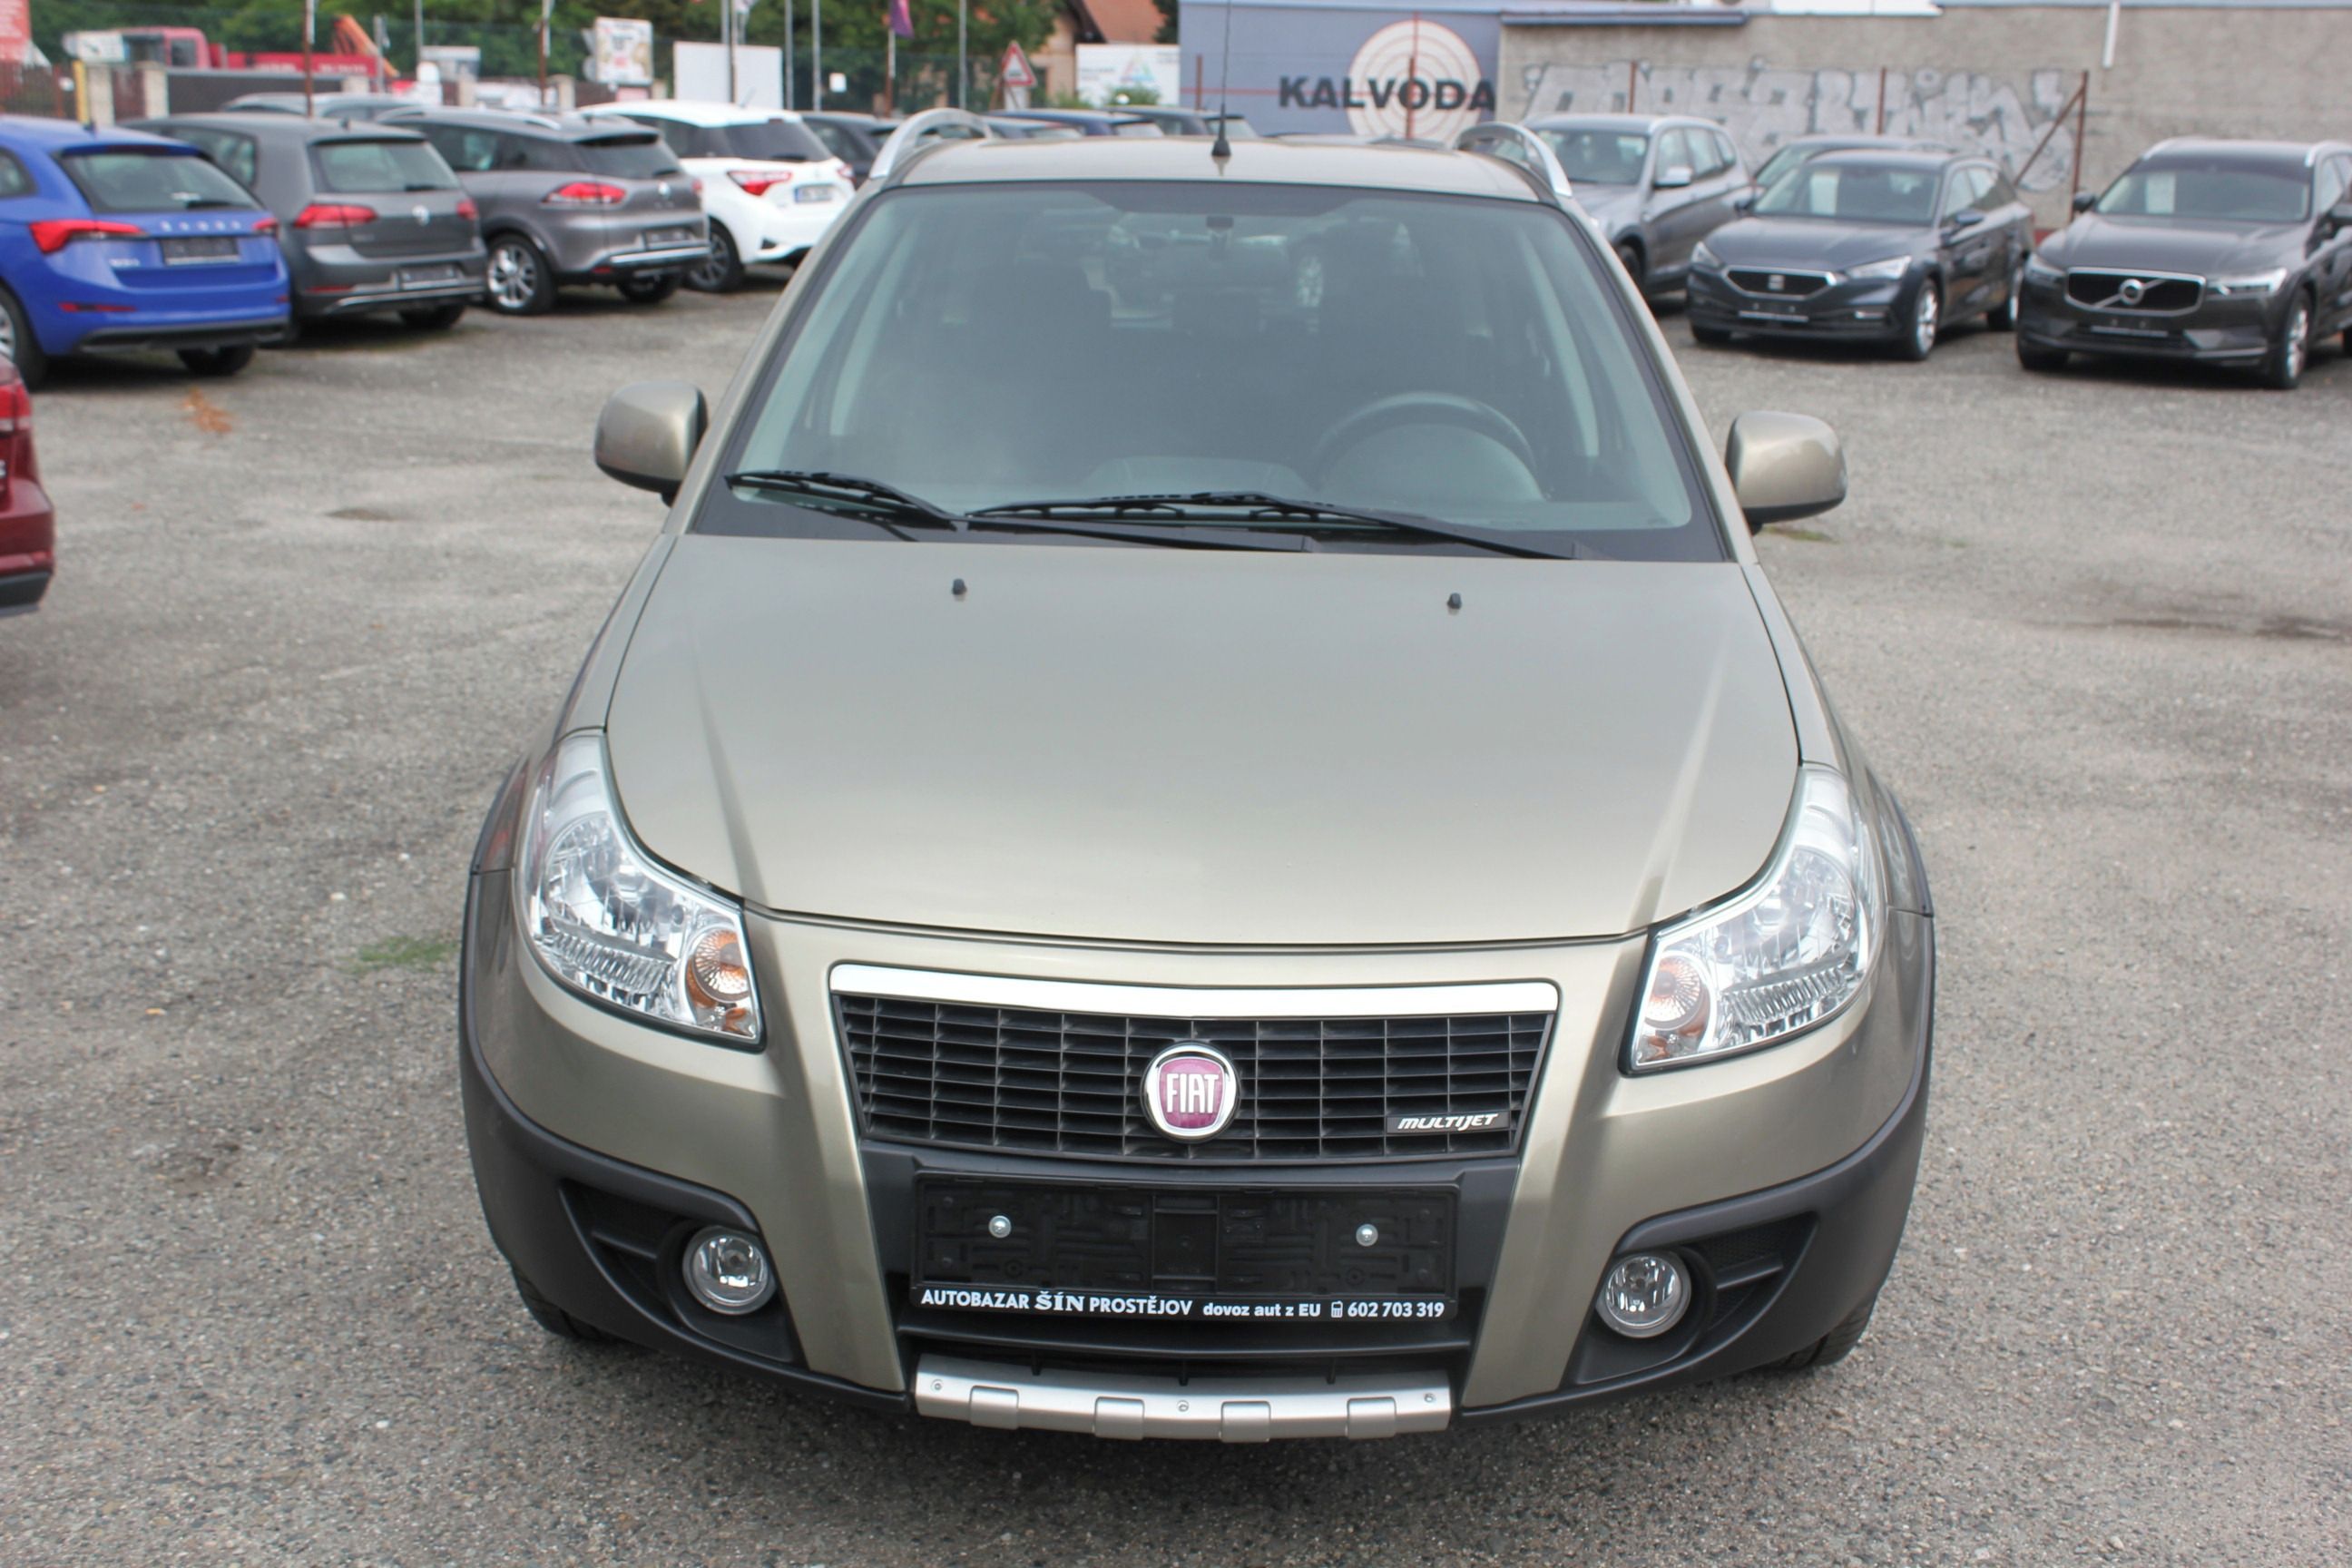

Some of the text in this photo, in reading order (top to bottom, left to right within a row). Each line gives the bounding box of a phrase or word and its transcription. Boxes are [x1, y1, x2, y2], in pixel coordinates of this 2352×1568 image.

[1279, 75, 1495, 111] KALVODA
[1166, 1073, 1219, 1113] FIAT
[1397, 1113, 1498, 1132] MULTIJET
[921, 1289, 1445, 1318] AUTOBAZAR ŠÍN PROSTĚJOV dovoz aut z EU 602 703 319
